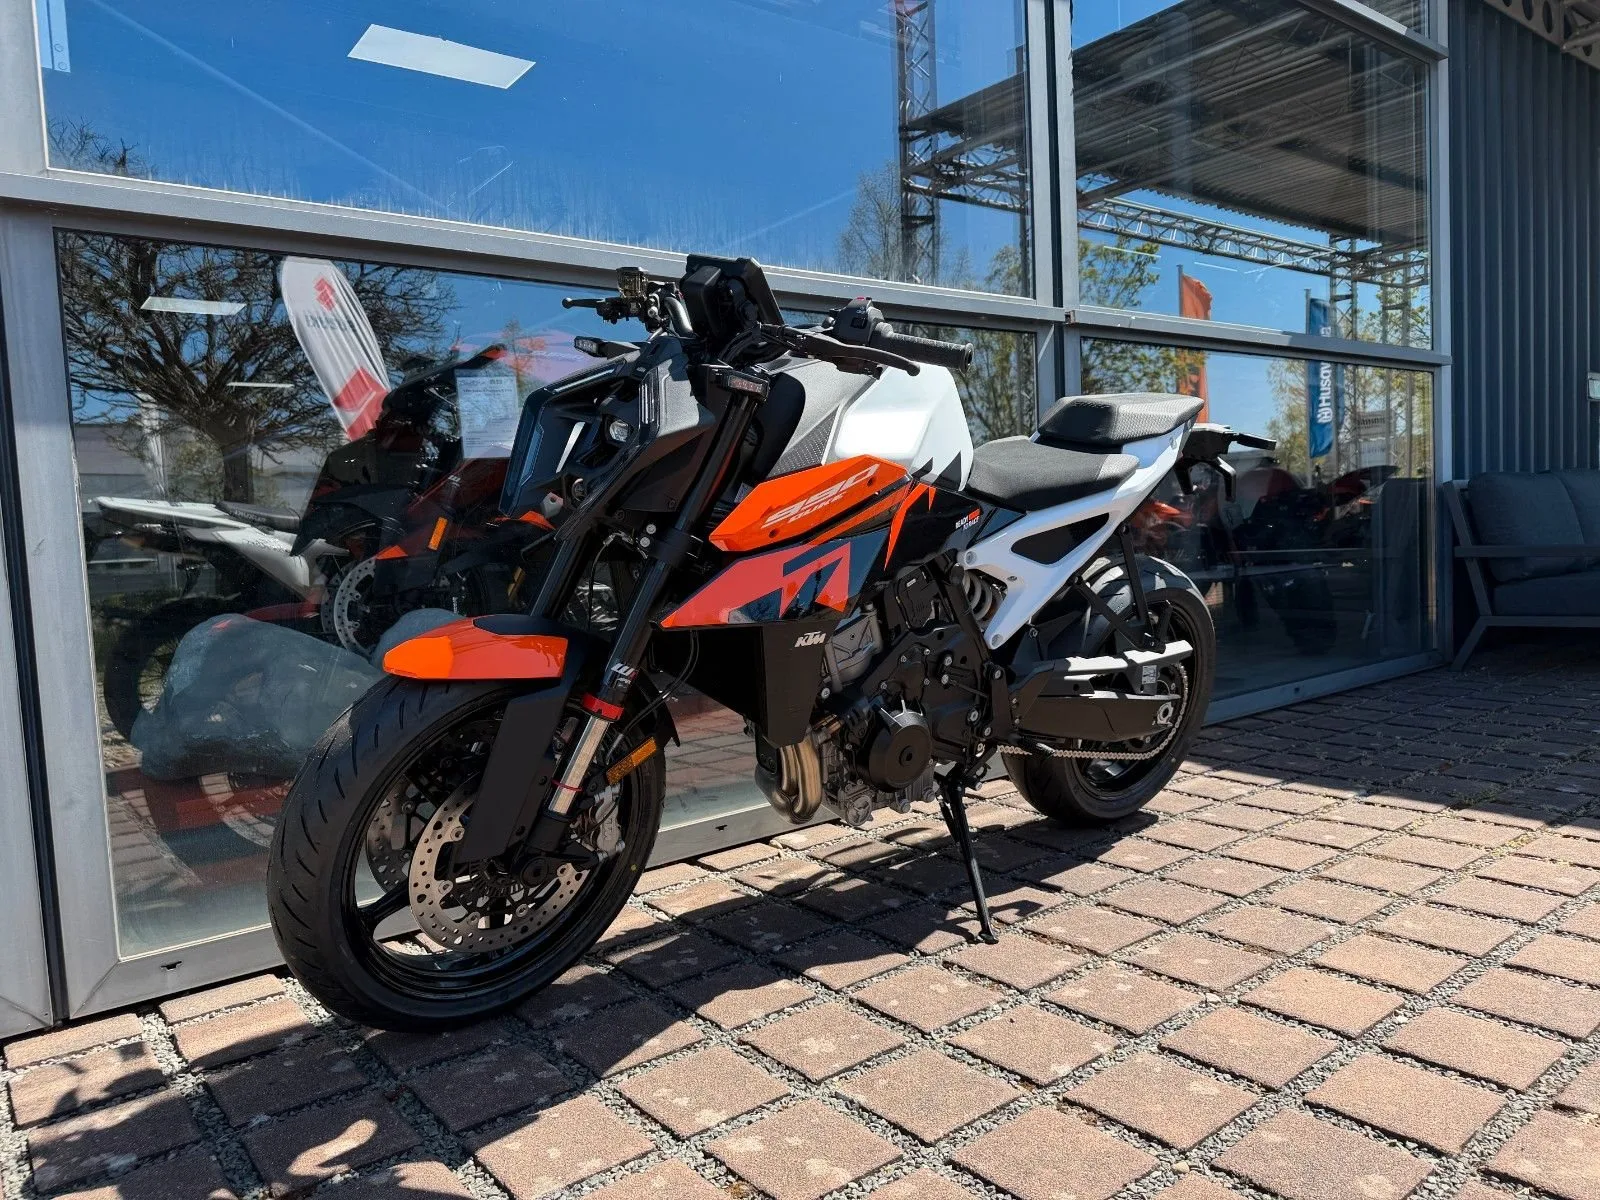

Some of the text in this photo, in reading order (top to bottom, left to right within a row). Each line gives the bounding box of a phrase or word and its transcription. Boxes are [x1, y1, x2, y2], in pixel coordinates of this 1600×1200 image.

[761, 463, 880, 529] 990
[787, 491, 847, 524] DUKE
[794, 630, 827, 648] KTM
